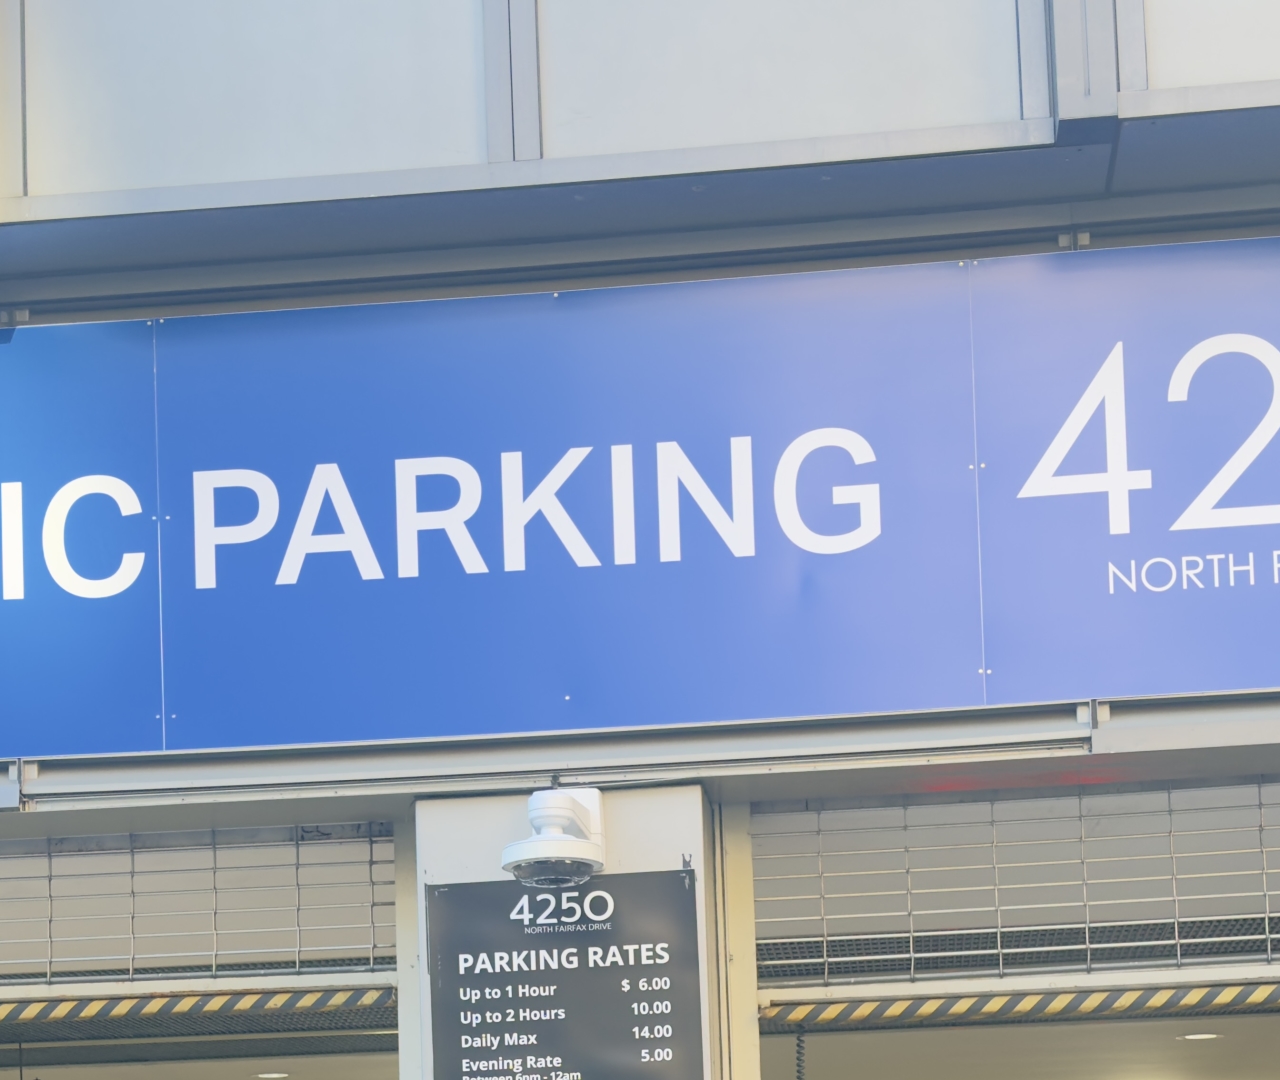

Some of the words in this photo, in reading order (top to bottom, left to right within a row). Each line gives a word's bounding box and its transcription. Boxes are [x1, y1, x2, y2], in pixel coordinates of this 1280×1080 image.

[192, 427, 882, 589] PARKING
[1108, 552, 1256, 594] NORTH
[510, 891, 614, 925] 4250
[459, 948, 578, 974] PARKING
[588, 943, 669, 967] RATES
[460, 988, 480, 1003] Up
[485, 988, 501, 999] to
[506, 986, 512, 997] 1
[519, 985, 556, 997] Hour
[622, 979, 630, 992] $
[639, 977, 670, 990] 6.00
[461, 1012, 481, 1027] Up
[486, 1011, 501, 1022] to
[506, 1009, 515, 1021] 2
[520, 1009, 565, 1021] Hours
[632, 1001, 671, 1015] 10.00
[462, 1034, 500, 1050] Daily
[505, 1033, 537, 1045] Max
[633, 1025, 672, 1038] 14.00
[462, 1057, 522, 1072] Evening
[527, 1056, 561, 1068] Rate
[641, 1048, 672, 1061] 5.00
[550, 1072, 581, 1080] 12am
